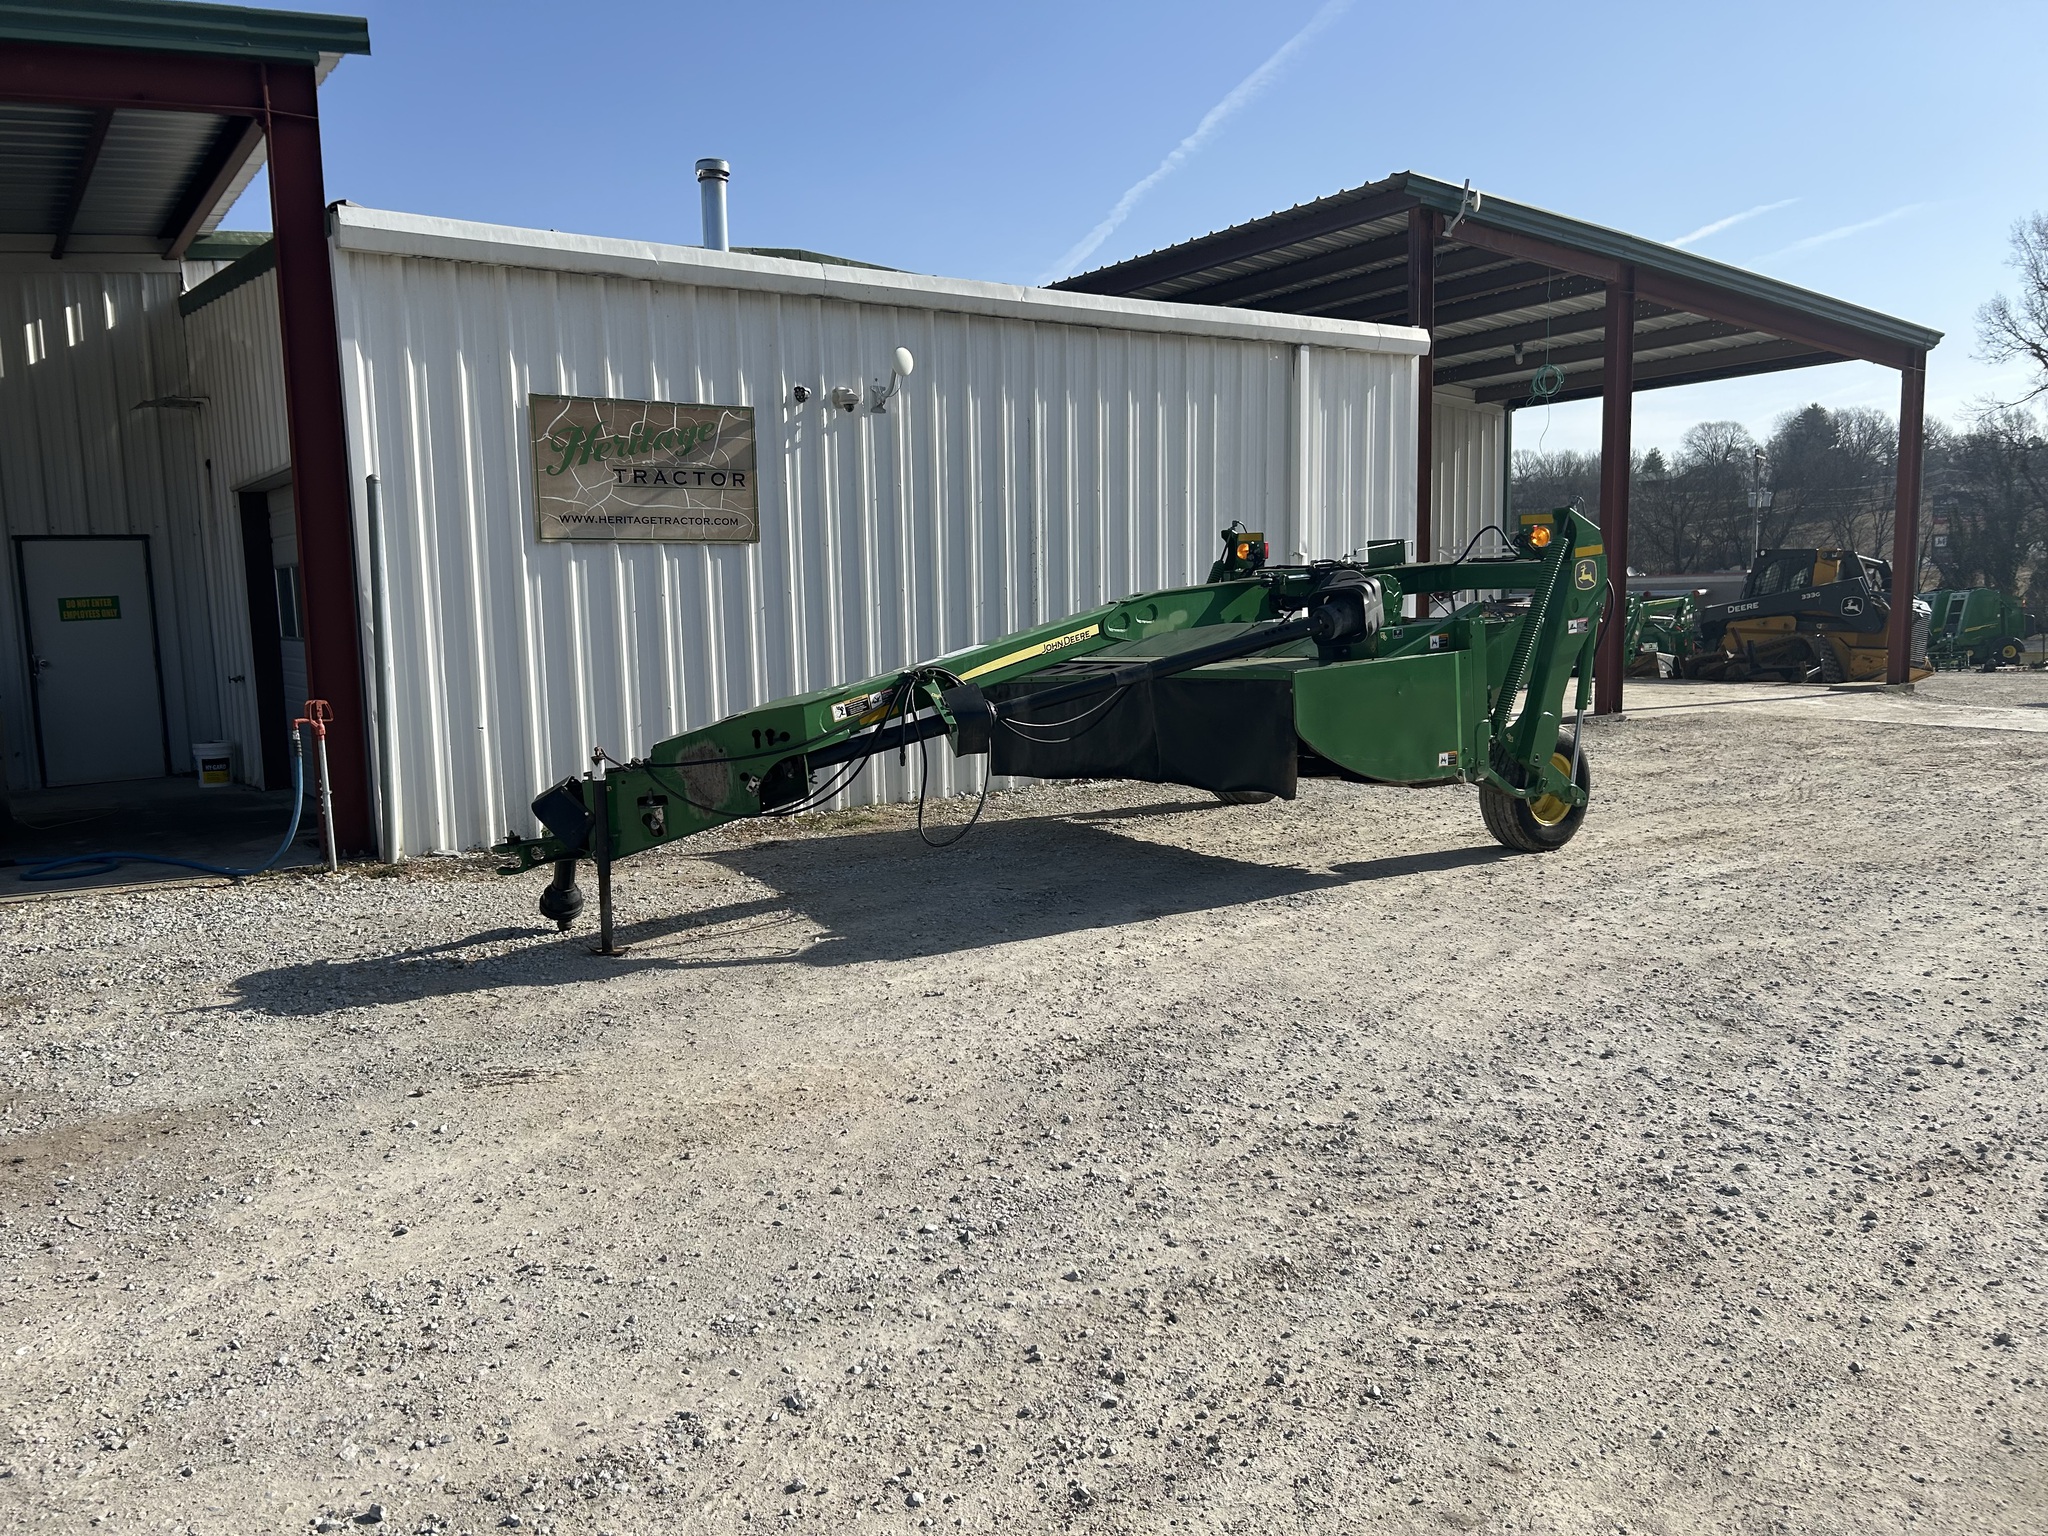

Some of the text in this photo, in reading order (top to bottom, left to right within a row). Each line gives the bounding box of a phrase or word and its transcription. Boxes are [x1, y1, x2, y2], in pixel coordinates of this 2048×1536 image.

[546, 420, 717, 476] Heritage
[613, 468, 746, 487] TRACTOR
[559, 514, 739, 526] WWW.HERITAGETRACTOR.COM
[1801, 592, 1821, 600] 333G
[66, 599, 112, 608] DO NOT ENTER
[1727, 602, 1759, 613] DEERE
[63, 608, 117, 619] EMPLOYEES ONLY
[1042, 631, 1090, 653] JOHN DEERE
